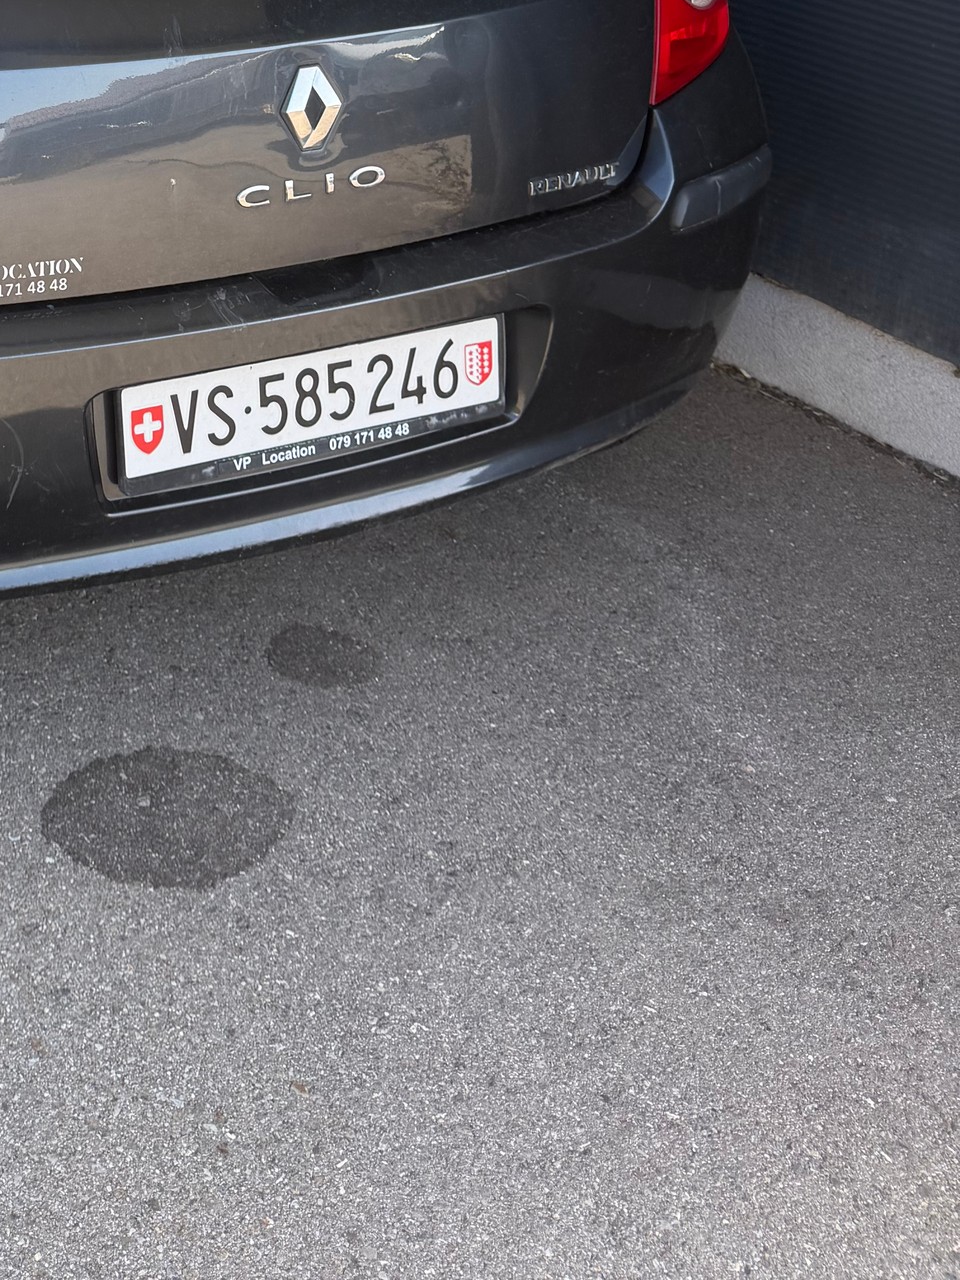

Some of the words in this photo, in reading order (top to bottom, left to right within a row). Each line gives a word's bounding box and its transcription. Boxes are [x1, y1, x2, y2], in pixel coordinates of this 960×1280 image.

[236, 165, 386, 208] CLIO
[527, 162, 620, 197] RENAULT
[27, 279, 46, 294] 48
[49, 277, 68, 292] 48
[233, 455, 252, 471] VP
[261, 444, 316, 466] Location
[329, 435, 351, 451] 079
[354, 429, 374, 446] 171
[377, 426, 392, 441] 48
[395, 422, 410, 437] 48
